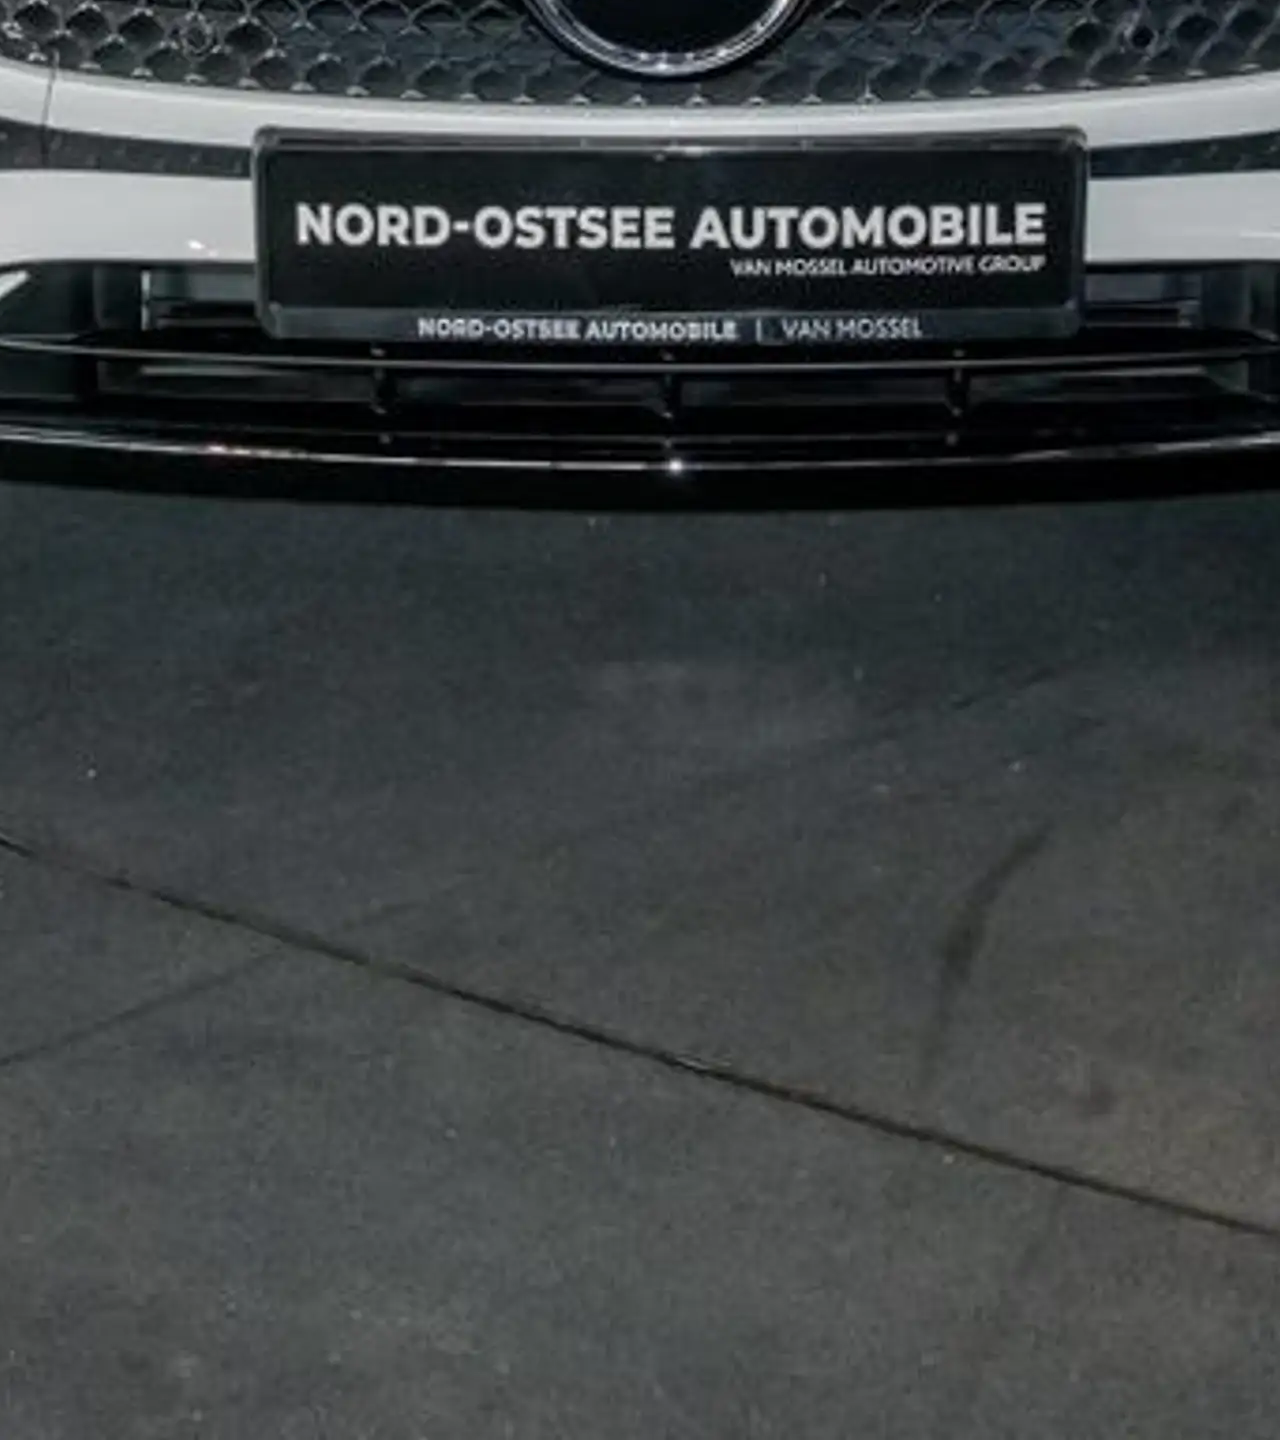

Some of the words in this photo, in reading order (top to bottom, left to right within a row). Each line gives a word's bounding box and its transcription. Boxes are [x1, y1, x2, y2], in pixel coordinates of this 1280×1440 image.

[295, 202, 676, 250] NORD-OSTSEE
[689, 202, 1047, 250] AUTOMOBILE
[729, 259, 772, 276] VAN
[775, 259, 847, 276] MOSSEL
[851, 256, 974, 276] AUTOMOTIVE
[977, 254, 1047, 273] GROUP
[416, 317, 581, 340] NORD-OSTSEE
[584, 317, 738, 341] AUTOMOBILE
[781, 318, 831, 339] VAN
[835, 317, 923, 339] MOSSEL
